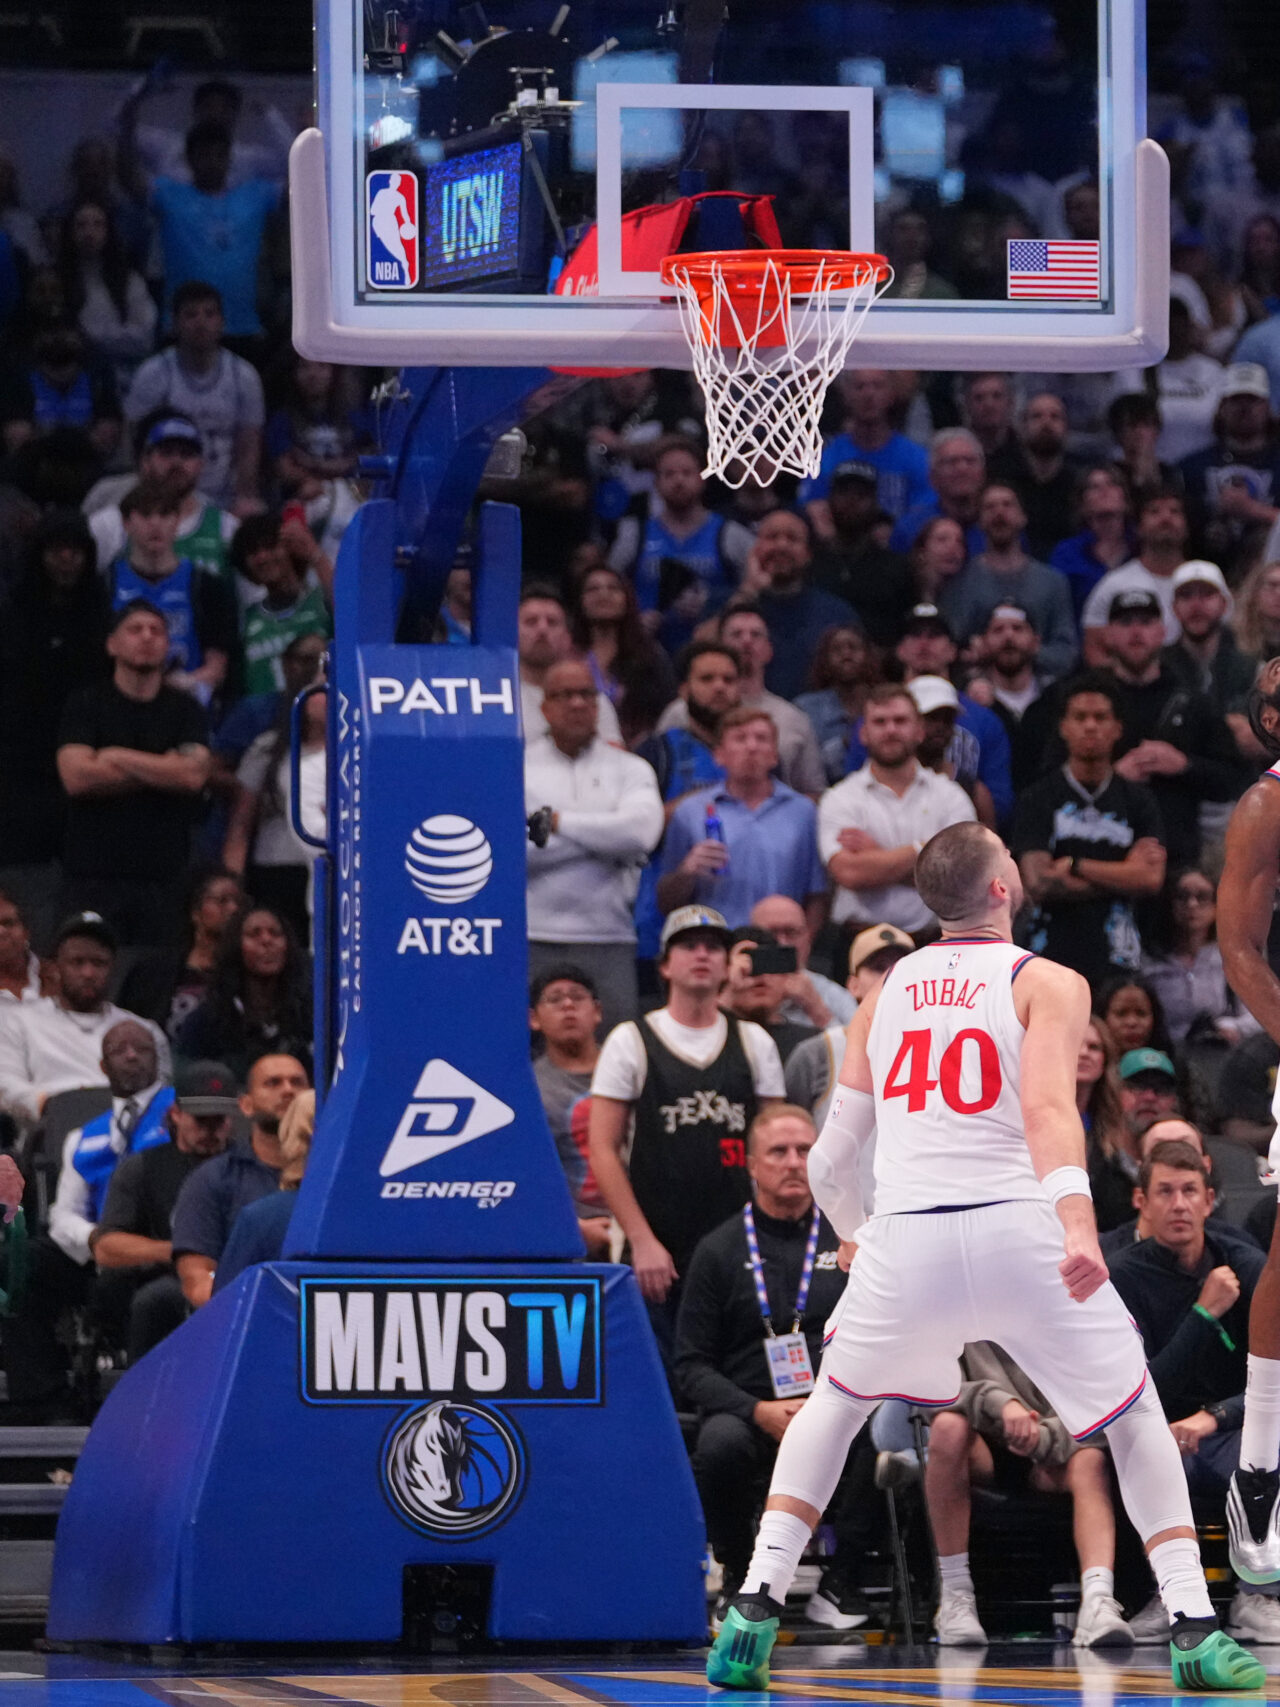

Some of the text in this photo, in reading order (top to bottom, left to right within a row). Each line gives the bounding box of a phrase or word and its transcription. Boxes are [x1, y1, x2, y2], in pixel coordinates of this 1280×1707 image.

[442, 170, 504, 263] UTSW
[375, 261, 399, 281] NBA
[369, 677, 514, 714] PATH
[397, 917, 502, 955] AT&T
[905, 978, 987, 1011] ZUBAC
[883, 1028, 1003, 1115] 40
[659, 1089, 746, 1134] TEXAS
[720, 1138, 747, 1167] 31
[379, 1181, 516, 1198] DENAGO
[477, 1198, 502, 1209] EV
[314, 1291, 587, 1392] MAVS TV
